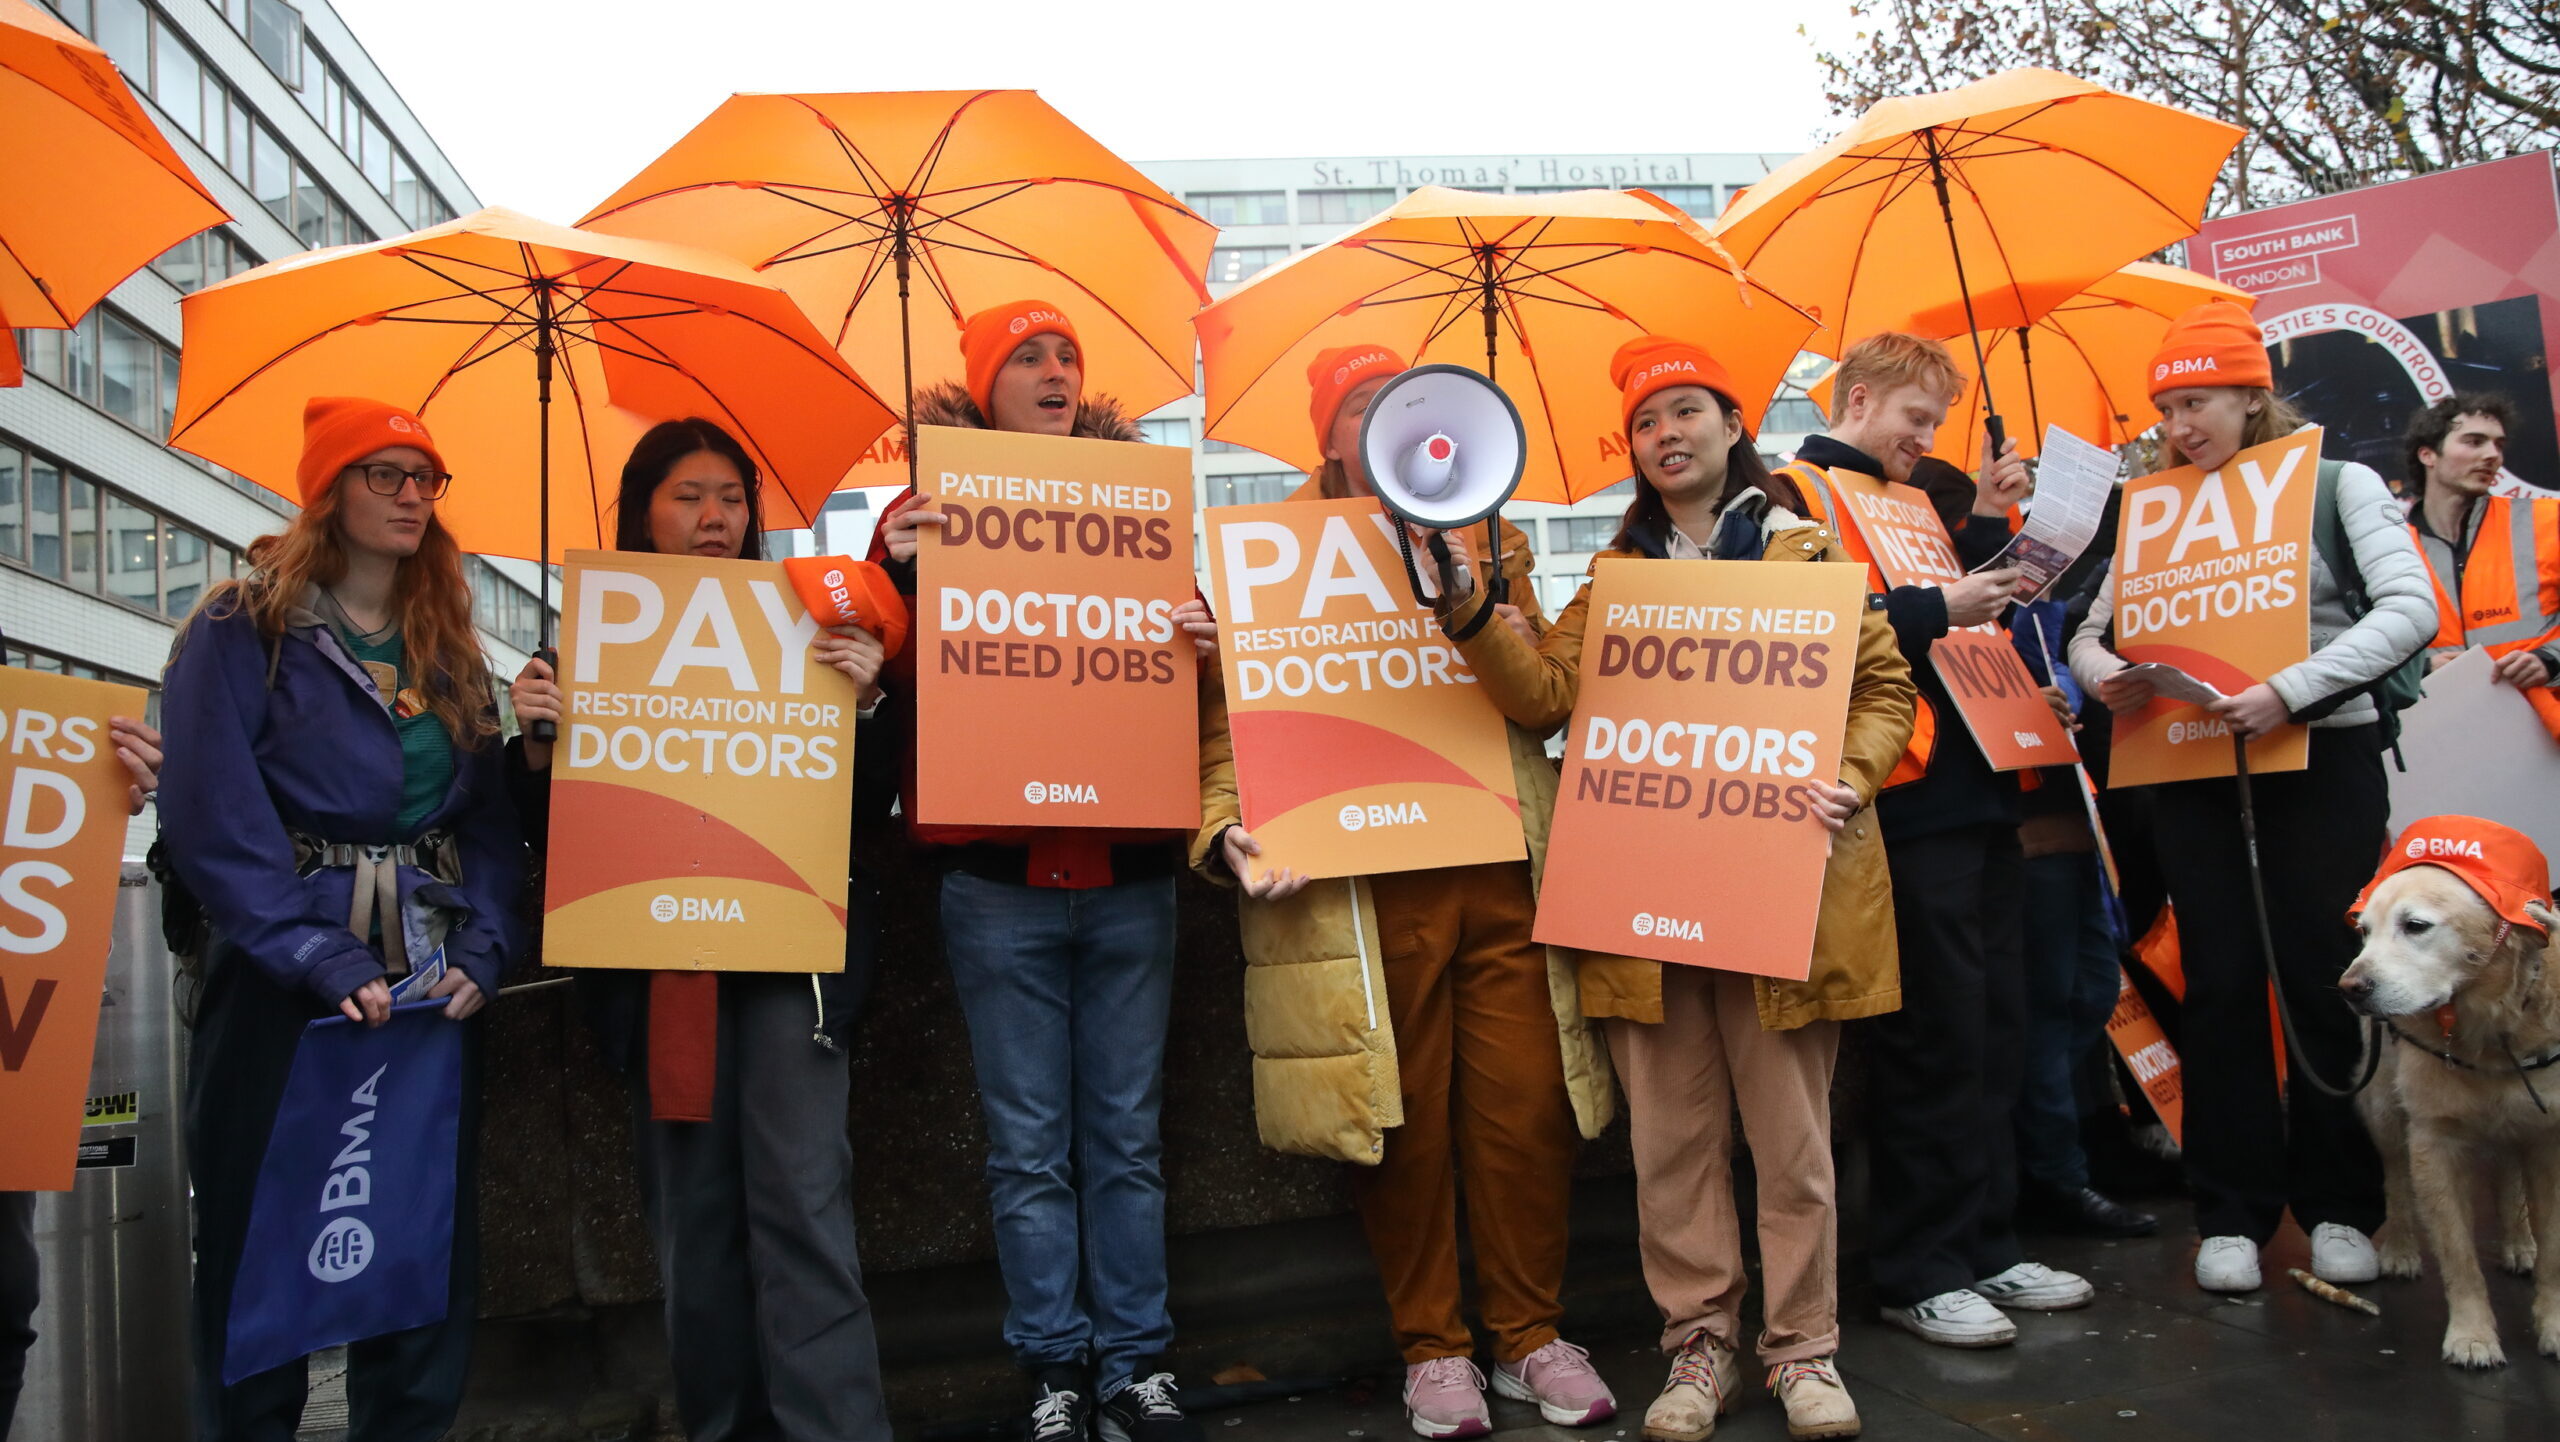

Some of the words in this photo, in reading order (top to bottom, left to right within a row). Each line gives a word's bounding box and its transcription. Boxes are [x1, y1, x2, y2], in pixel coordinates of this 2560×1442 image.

[1314, 161, 1352, 186] St.
[1540, 157, 1692, 187] Hospital
[2223, 238, 2286, 262] SOUTH
[2290, 226, 2344, 249] BANK
[1029, 310, 1069, 330] BMA
[1349, 352, 1389, 371] BMA
[1651, 360, 1697, 377] BMA
[2172, 356, 2218, 375] BMA
[2345, 310, 2447, 402] COURTROO
[941, 472, 1083, 506] PATIENTS
[1092, 483, 1172, 512] NEED
[1854, 491, 1939, 533] DOCTORS
[2123, 445, 2308, 575] PAY
[940, 503, 1172, 561] DOCTORS
[1872, 524, 1962, 579] NEED
[2122, 551, 2250, 598] RESTORATION
[2255, 541, 2298, 570] FOR
[940, 587, 1174, 644] DOCTORS
[1605, 603, 1744, 633] PATIENTS
[1750, 608, 1836, 635] NEED
[2122, 569, 2297, 639] DOCTORS
[574, 568, 821, 695] PAY
[1233, 618, 1419, 653] RESTORATION
[941, 639, 1062, 679] NEED
[1071, 646, 1175, 687] JOBS
[1237, 646, 1479, 701] DOCTORS
[1598, 634, 1831, 689] DOCTORS
[1937, 644, 2033, 699] NOW
[572, 690, 776, 725] RESTORATION
[784, 702, 841, 728] FOR
[2186, 719, 2230, 741] BMA
[569, 723, 839, 780] DOCTORS
[1584, 716, 1818, 778] DOCTORS
[1049, 784, 1099, 804] BMA
[1367, 801, 1428, 827] BMA
[1577, 767, 1692, 810] NEED
[1698, 778, 1810, 823] JOBS
[2429, 838, 2484, 860] BMA
[682, 897, 745, 922] BMA
[1655, 917, 1704, 943] BMA
[320, 1062, 388, 1213] BMA
